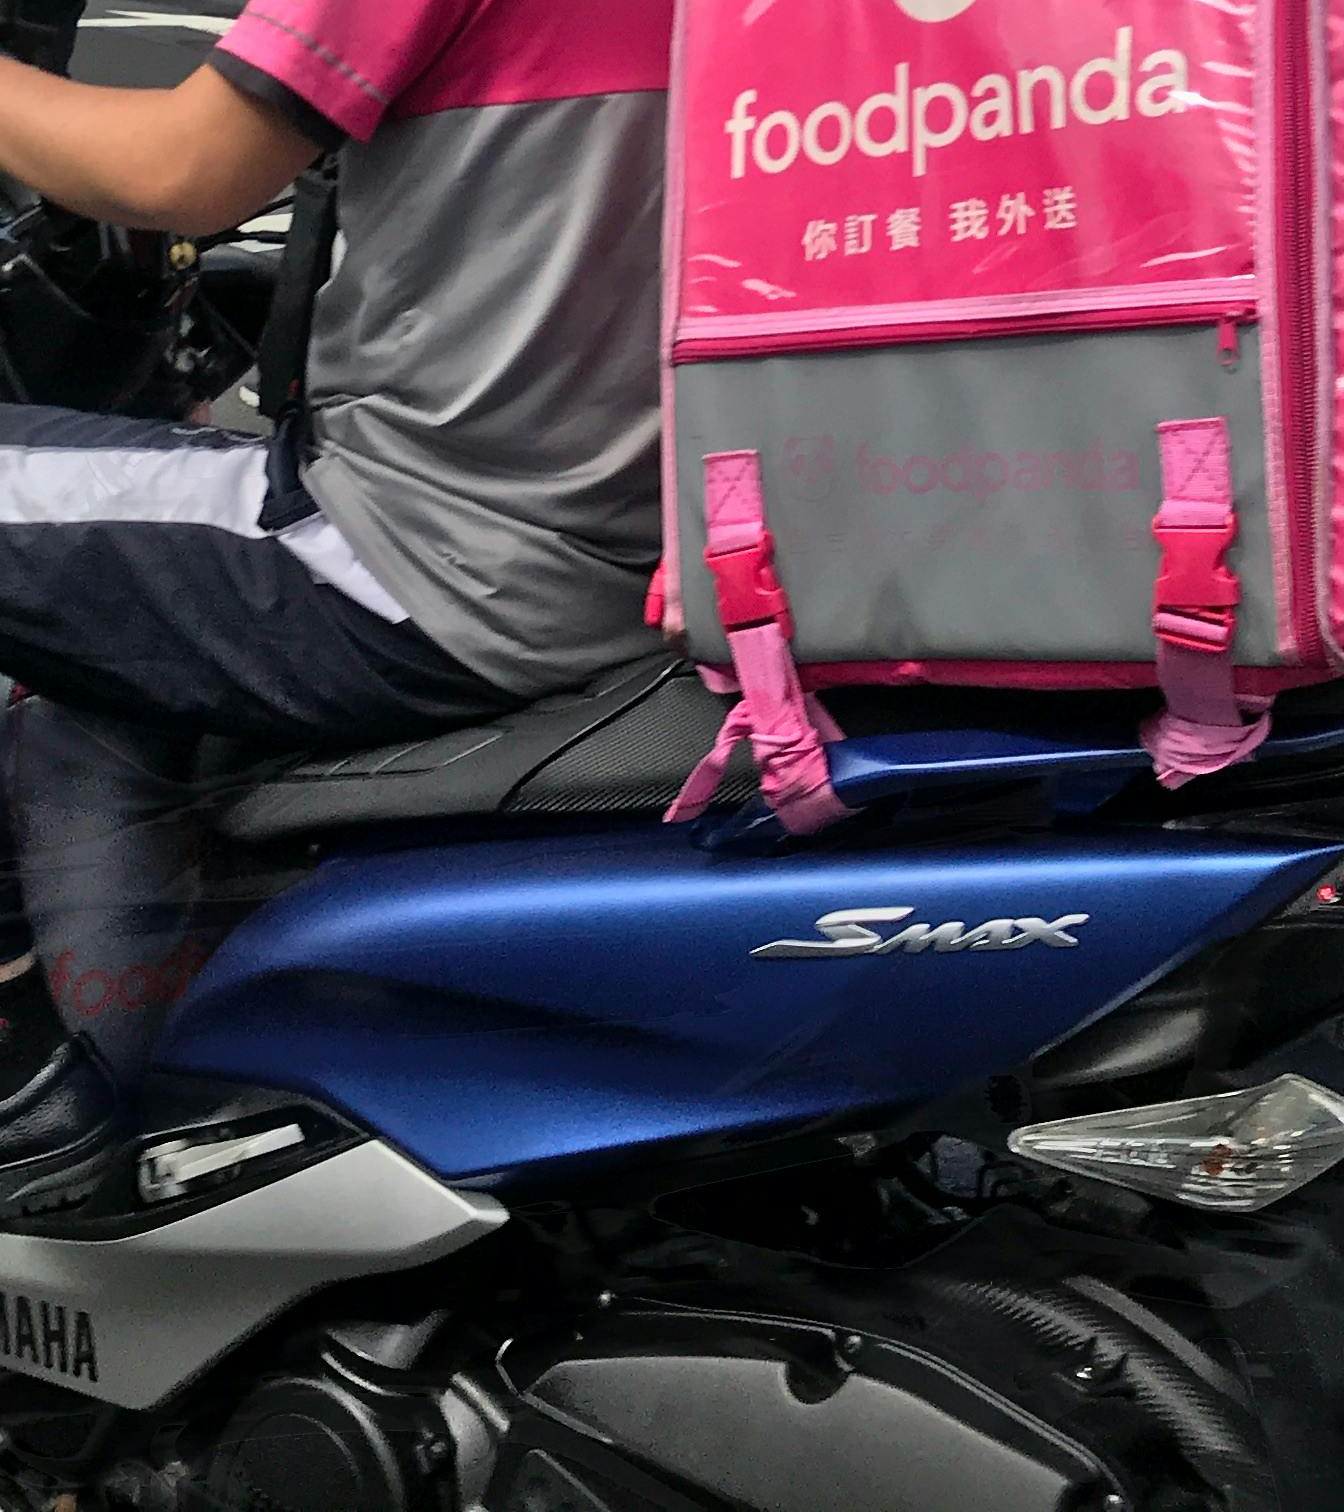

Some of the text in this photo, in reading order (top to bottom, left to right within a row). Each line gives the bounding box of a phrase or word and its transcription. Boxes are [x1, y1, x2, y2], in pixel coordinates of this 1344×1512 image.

[724, 26, 1190, 179] foodpanda
[802, 185, 1079, 262] 你訂餐 我外送
